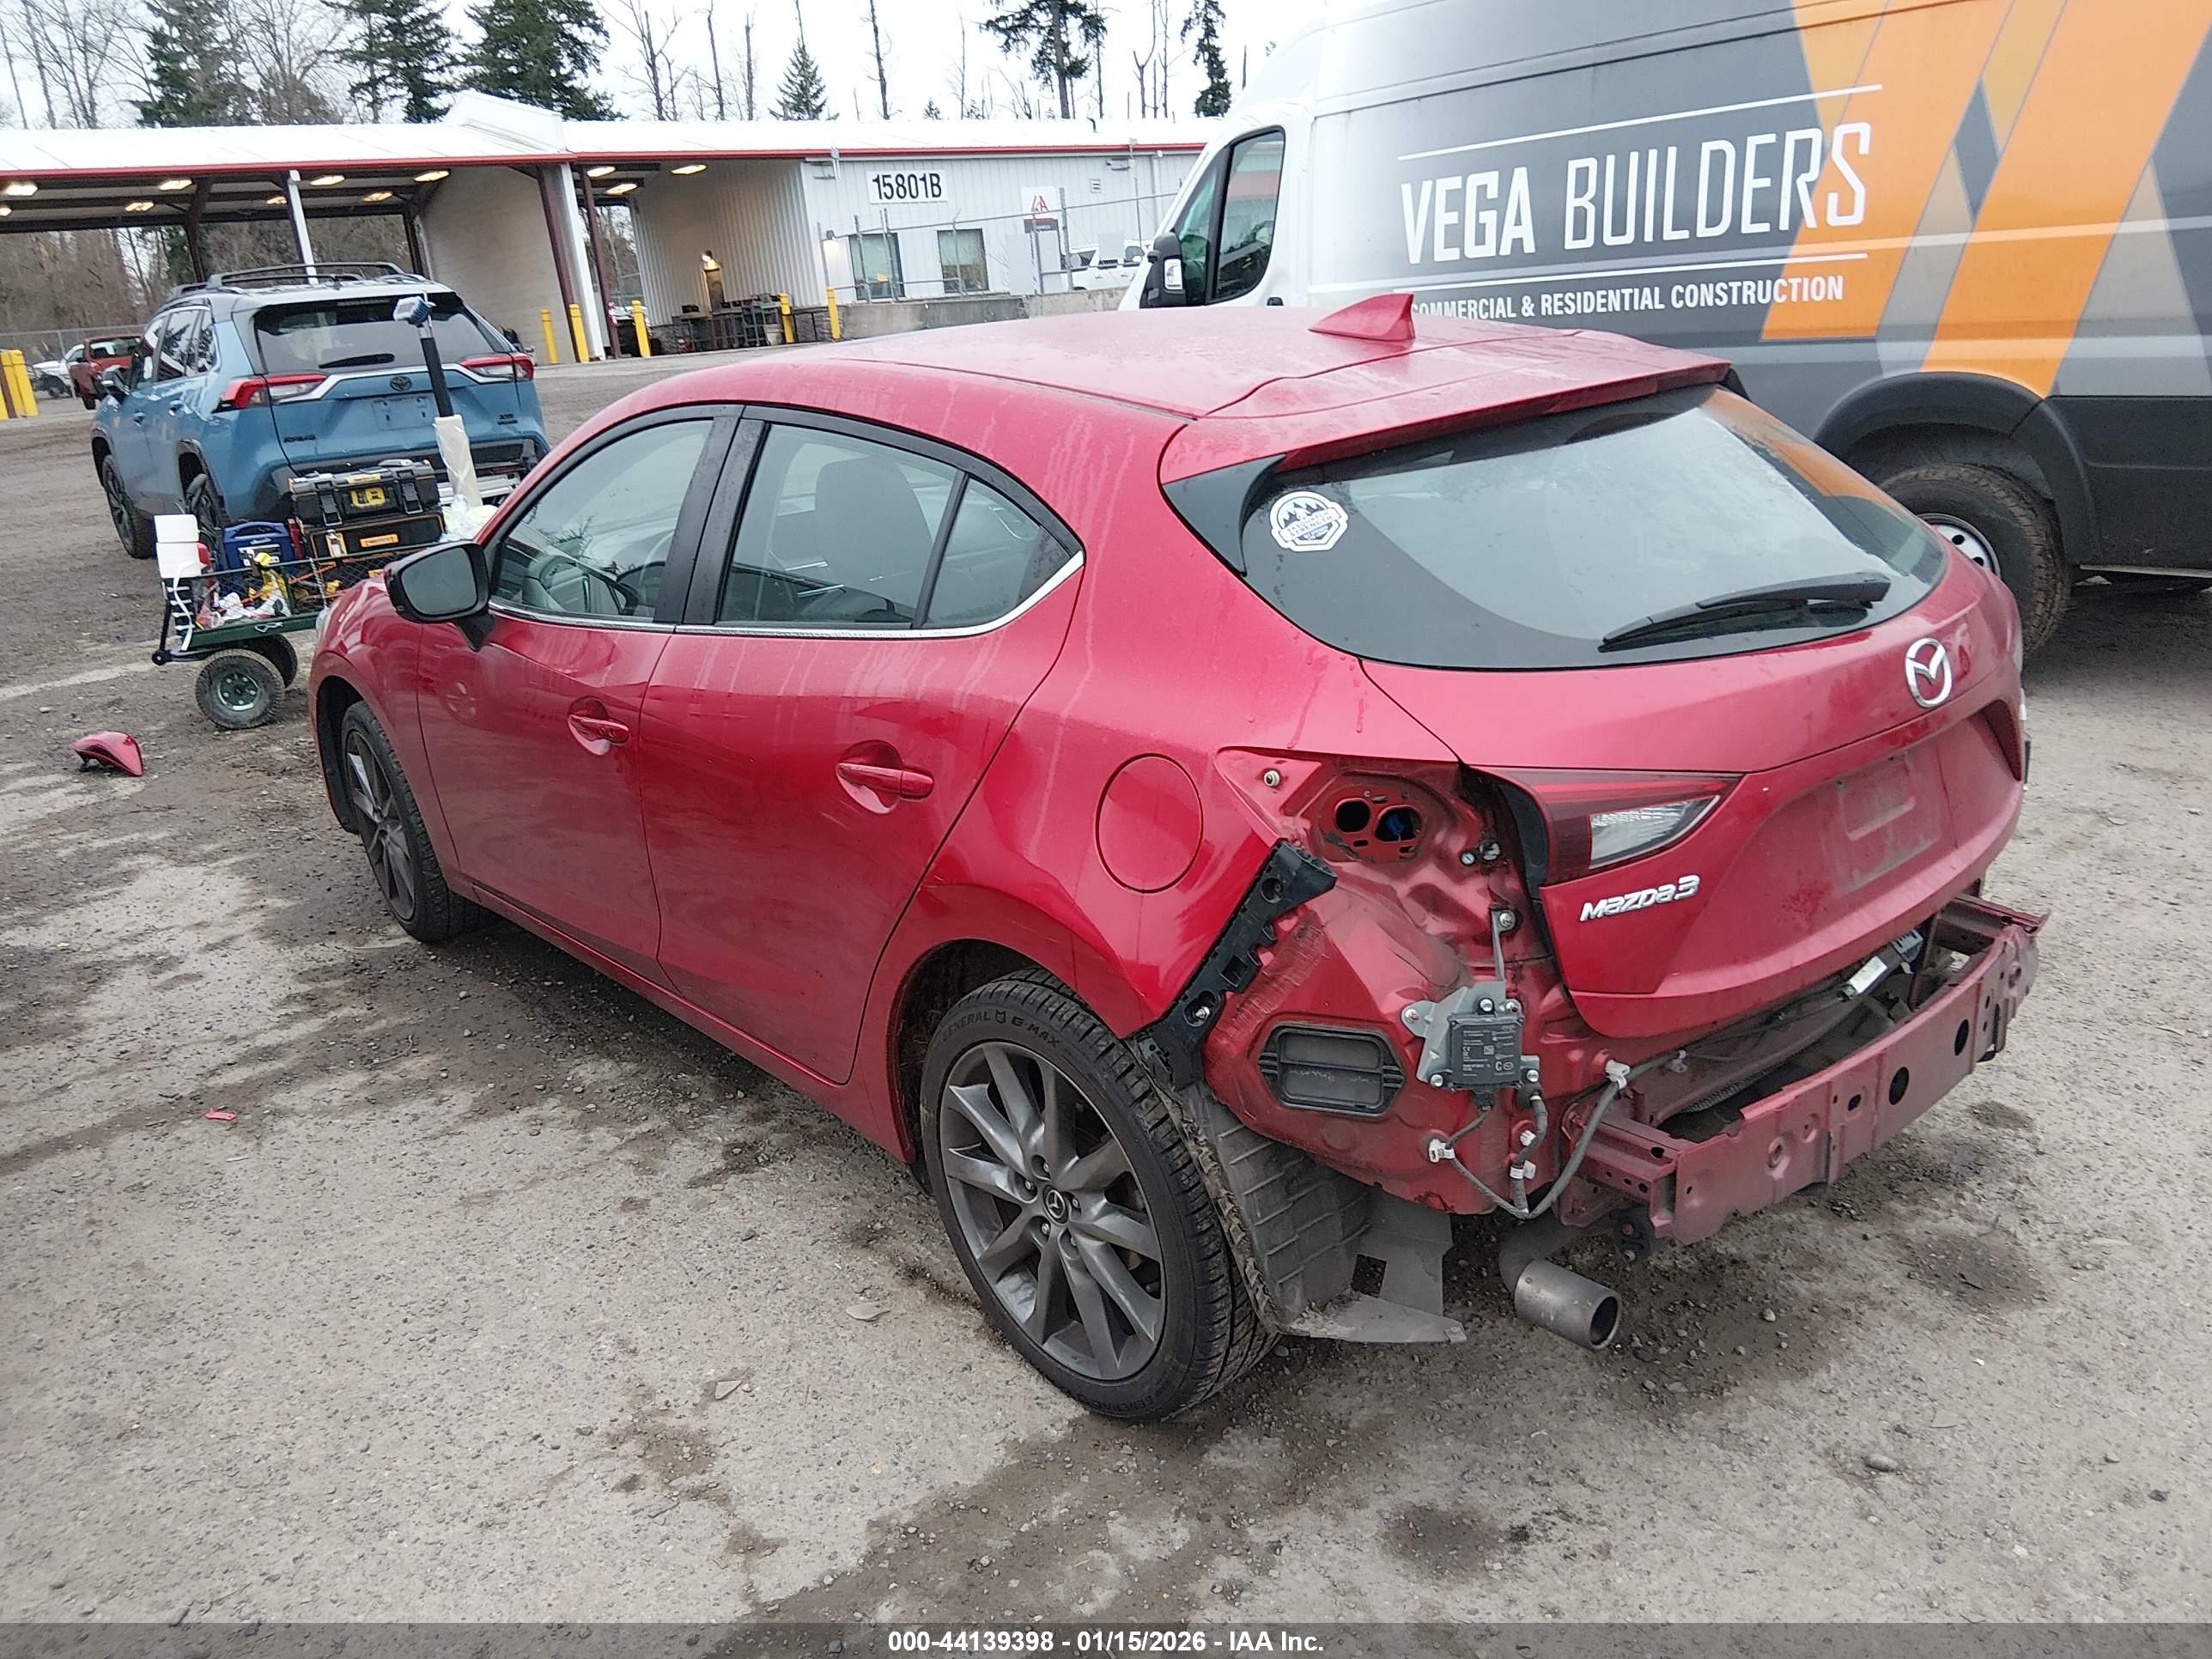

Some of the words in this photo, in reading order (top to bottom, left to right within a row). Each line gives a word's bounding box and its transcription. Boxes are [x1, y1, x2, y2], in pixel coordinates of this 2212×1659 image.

[872, 173, 942, 200] 15801B
[1401, 167, 1536, 264] VEGA
[1564, 121, 1871, 251] BUILDERS
[1521, 295, 1535, 317] &
[1540, 285, 1665, 316] RESIDENTIAL
[1671, 276, 1844, 309] CONSTRUCTION
